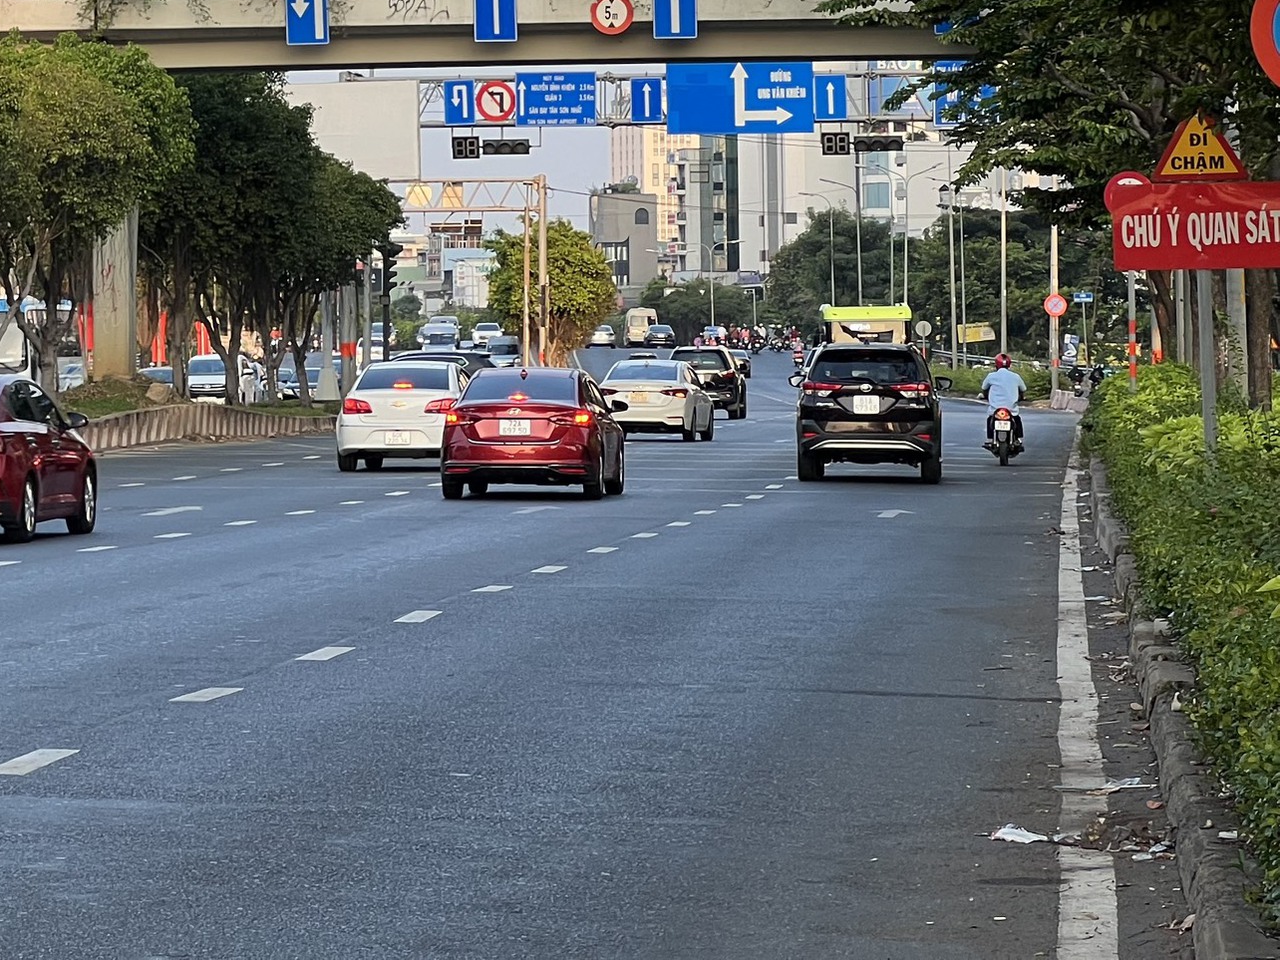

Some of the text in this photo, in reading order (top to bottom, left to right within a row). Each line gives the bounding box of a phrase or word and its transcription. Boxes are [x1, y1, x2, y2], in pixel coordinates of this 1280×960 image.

[1189, 132, 1208, 147] ĐI
[1170, 152, 1225, 173] CHẬM
[1121, 203, 1280, 252] CHÚ Ý QUAN SÁT
